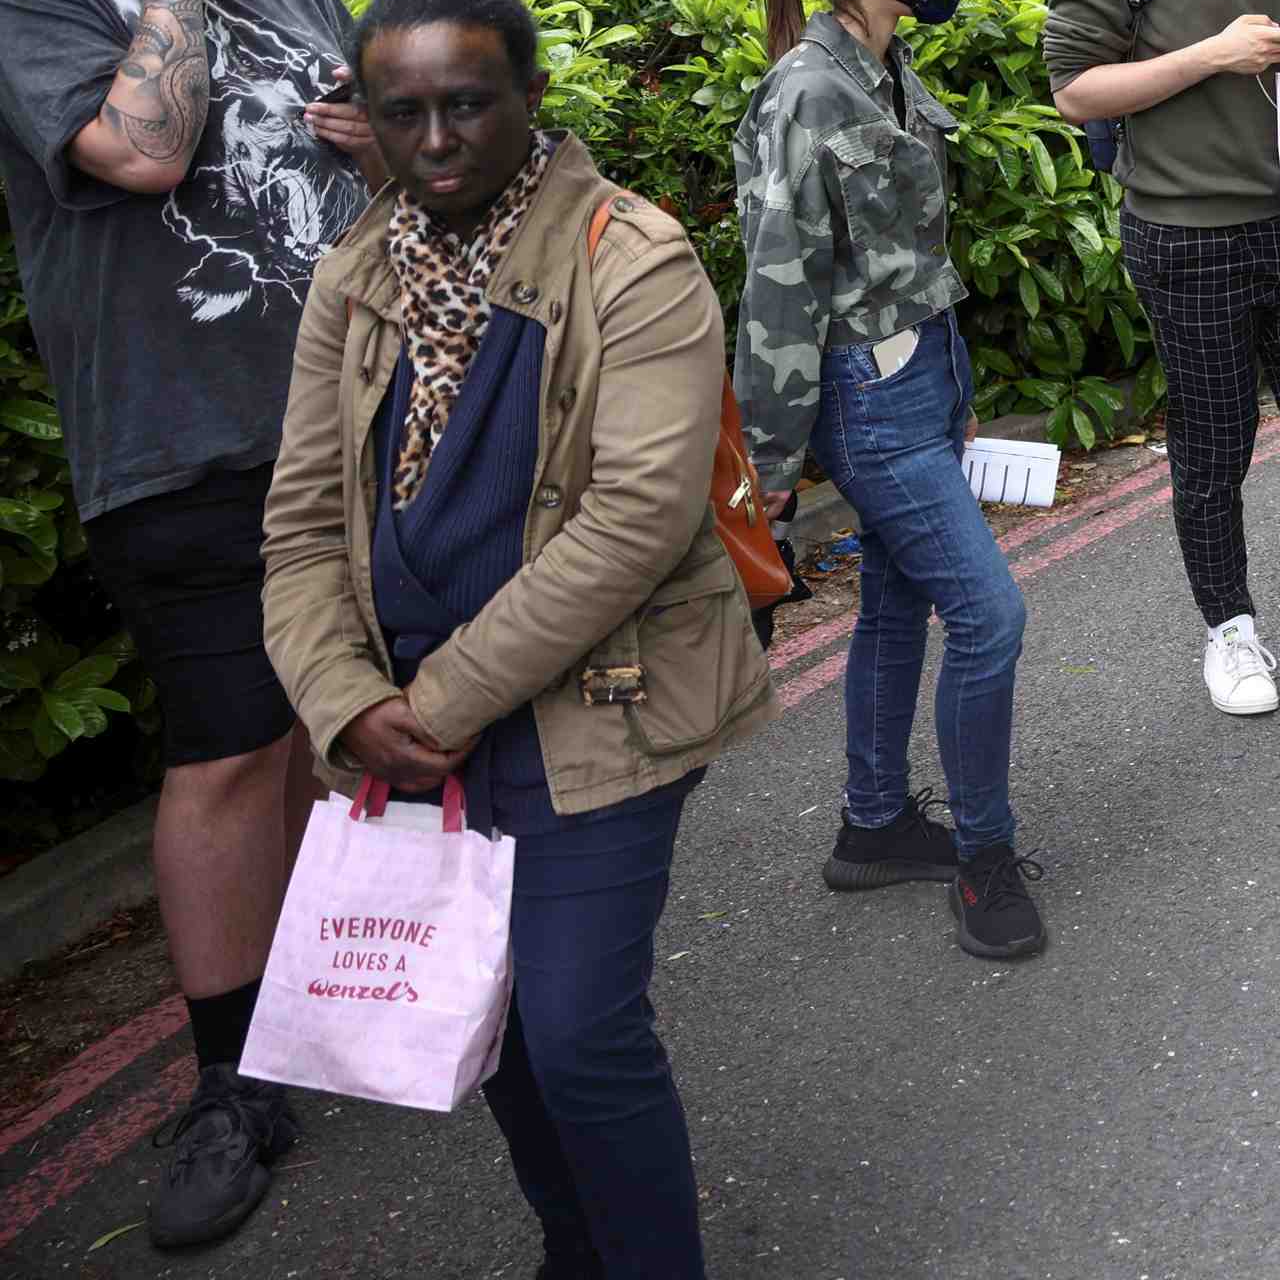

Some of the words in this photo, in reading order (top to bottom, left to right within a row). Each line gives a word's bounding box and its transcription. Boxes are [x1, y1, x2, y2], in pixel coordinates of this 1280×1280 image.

[320, 917, 437, 948] EVERYONE
[332, 951, 389, 972] LOVES
[395, 954, 406, 973] A
